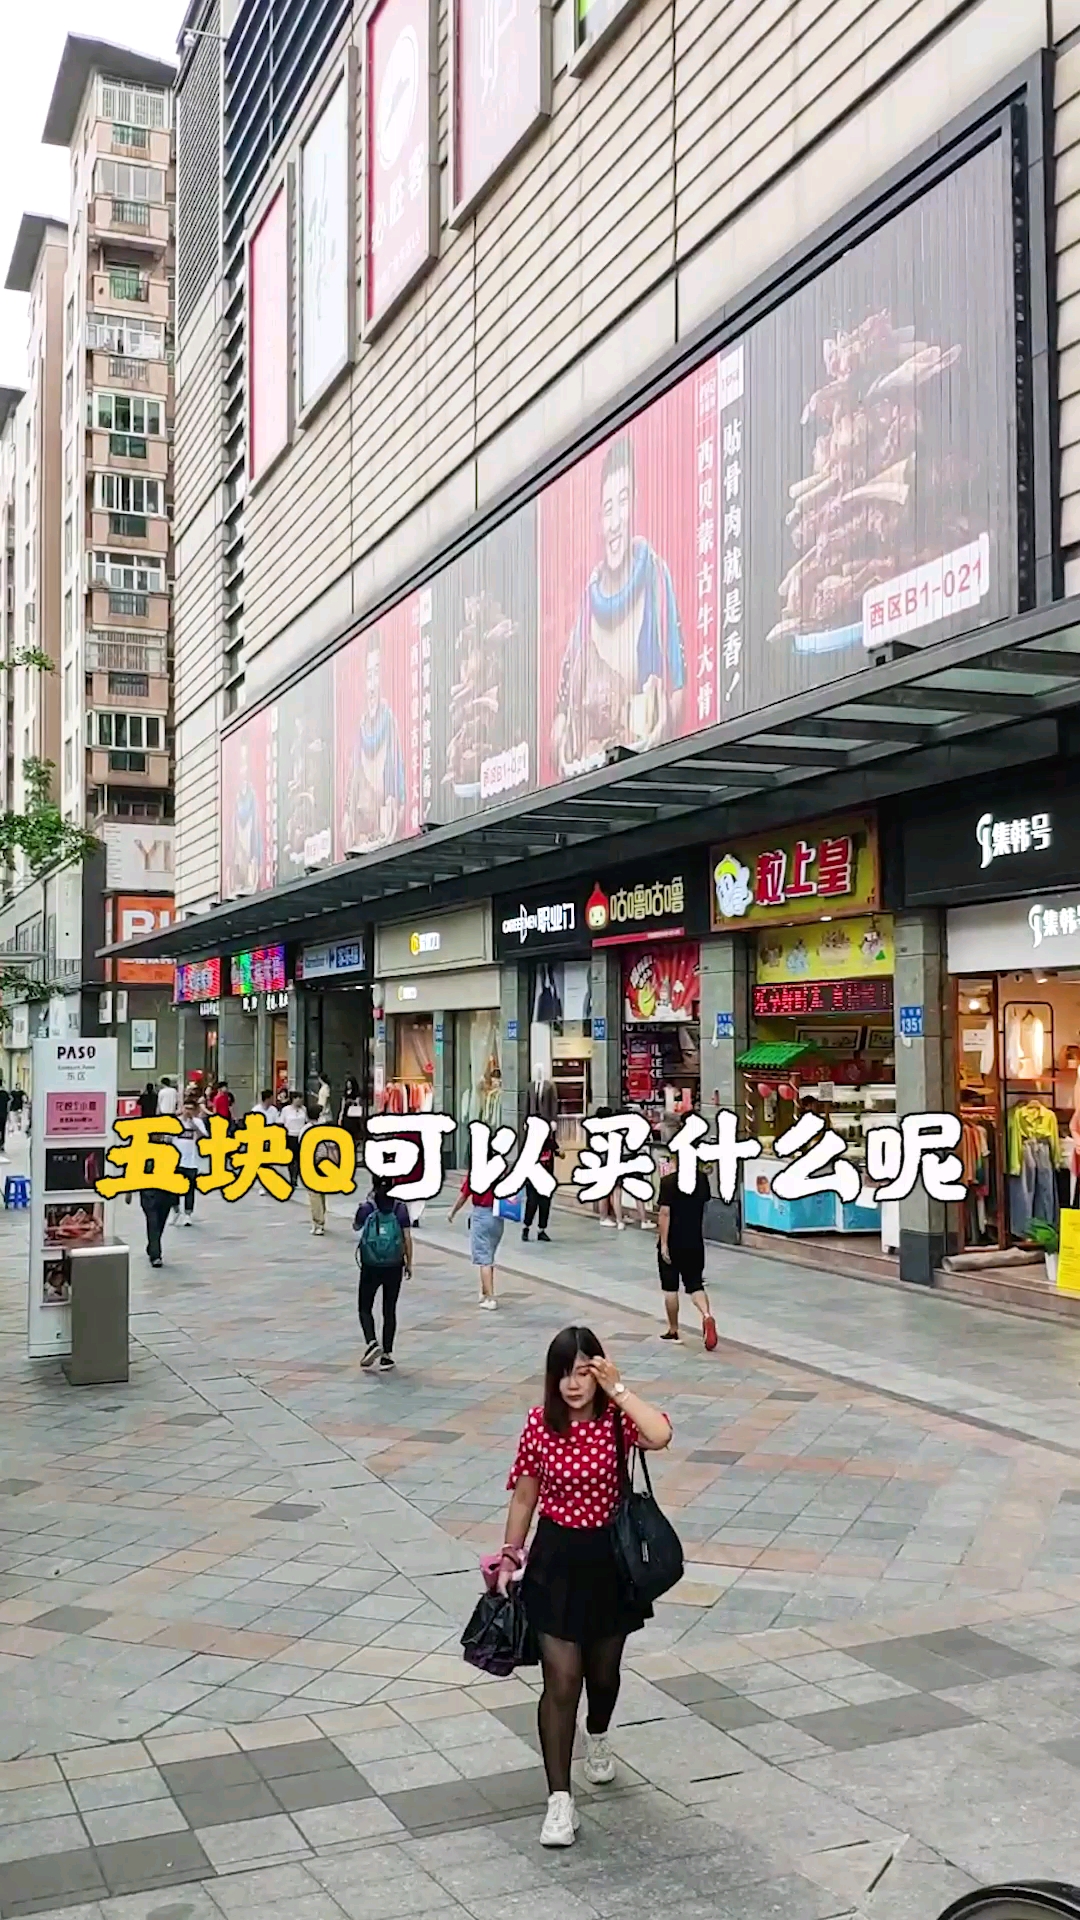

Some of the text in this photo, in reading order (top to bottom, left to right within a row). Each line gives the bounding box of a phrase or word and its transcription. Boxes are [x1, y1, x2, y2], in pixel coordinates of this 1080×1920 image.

[868, 557, 982, 629] 西区B1-021
[992, 812, 1053, 858] 集韩号
[755, 836, 853, 906] 粒上皇
[537, 902, 576, 934] 职业门
[610, 875, 685, 923] 咕噜咕噜
[1043, 905, 1080, 937] 集韩
[901, 1018, 922, 1033] 1351
[57, 1046, 96, 1060] PASO
